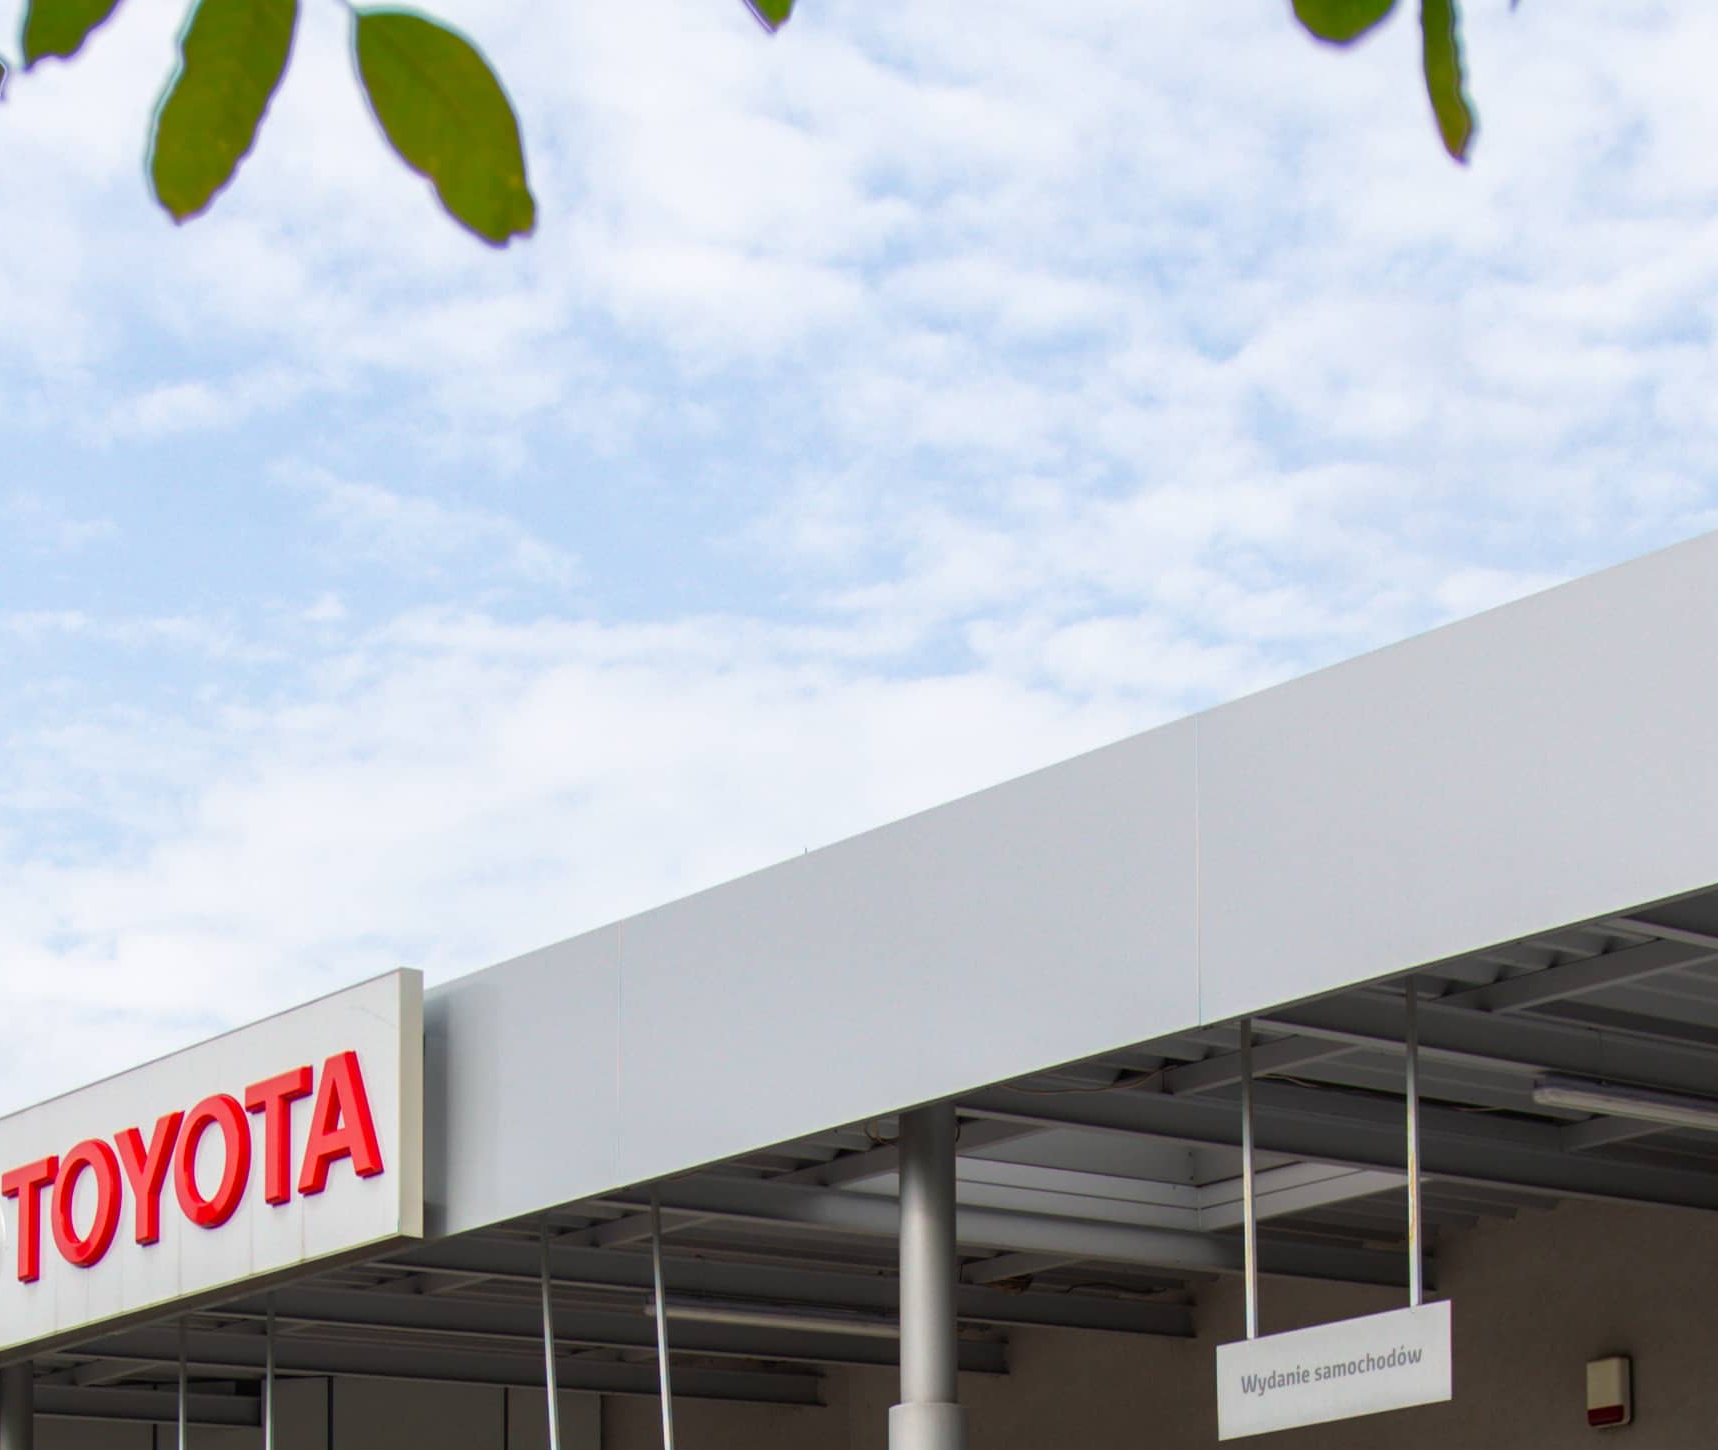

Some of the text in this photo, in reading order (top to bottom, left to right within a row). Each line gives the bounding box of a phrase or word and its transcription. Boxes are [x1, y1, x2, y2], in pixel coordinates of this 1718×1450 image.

[1, 1050, 384, 1283] TOYOTA
[1241, 1345, 1423, 1397] Wydanie samochodów
